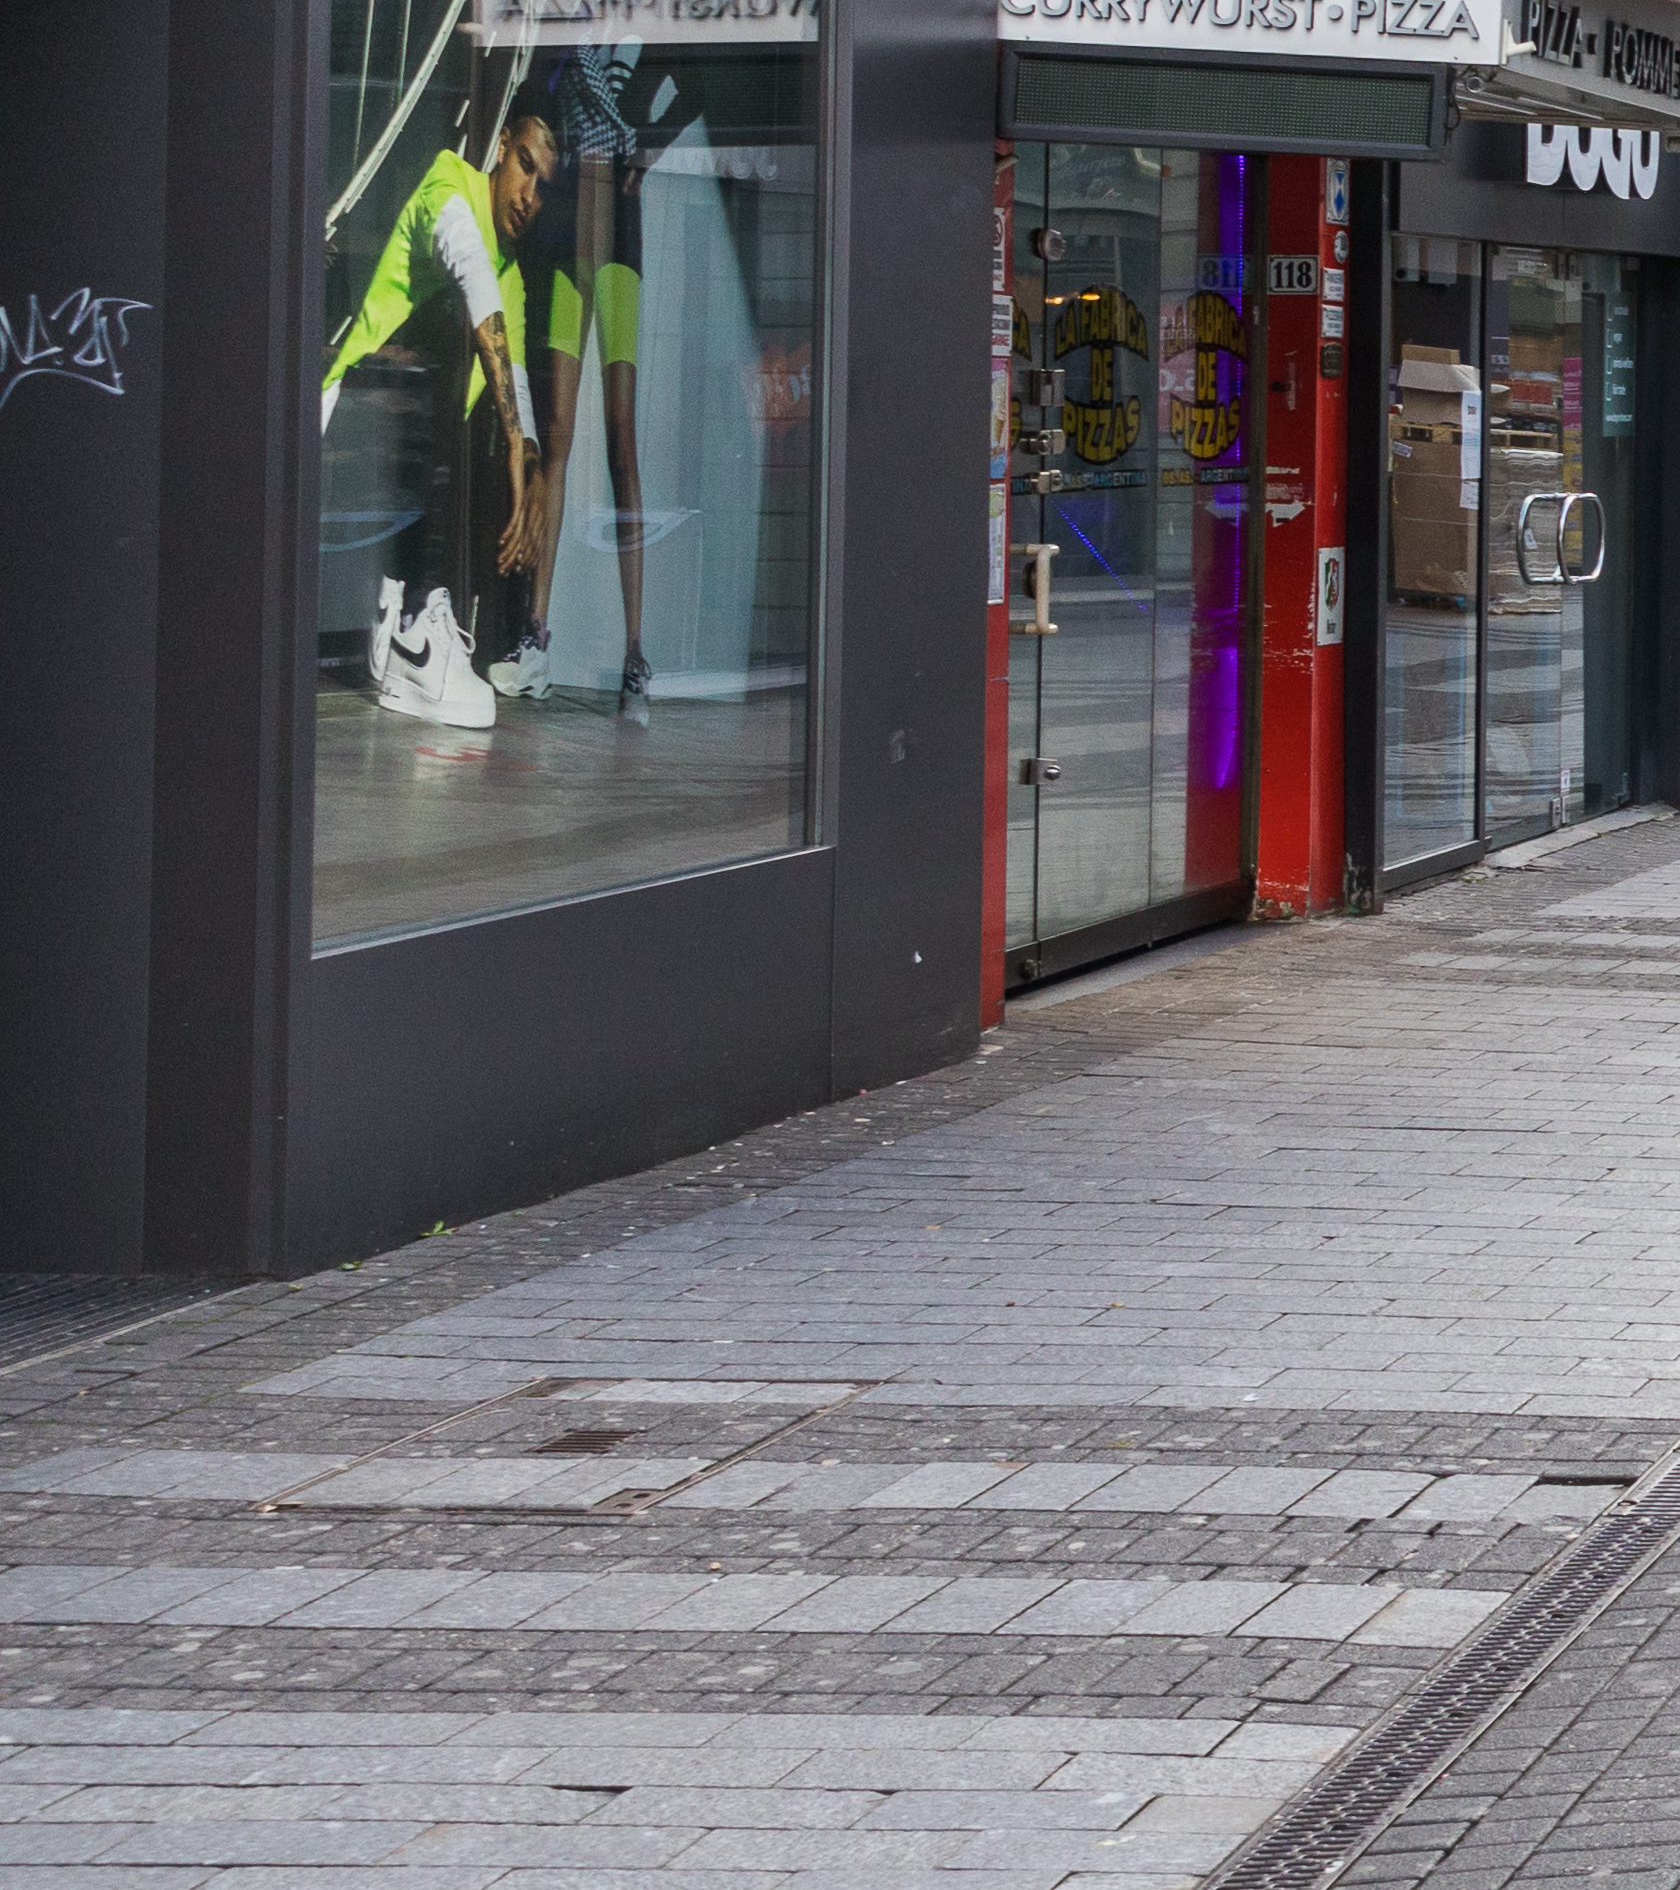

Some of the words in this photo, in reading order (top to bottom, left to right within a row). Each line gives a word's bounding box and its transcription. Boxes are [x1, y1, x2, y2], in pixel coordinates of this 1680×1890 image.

[1272, 261, 1313, 290] 118
[1062, 394, 1142, 465] PIZZAS
[1170, 394, 1241, 461] PIZZAS
